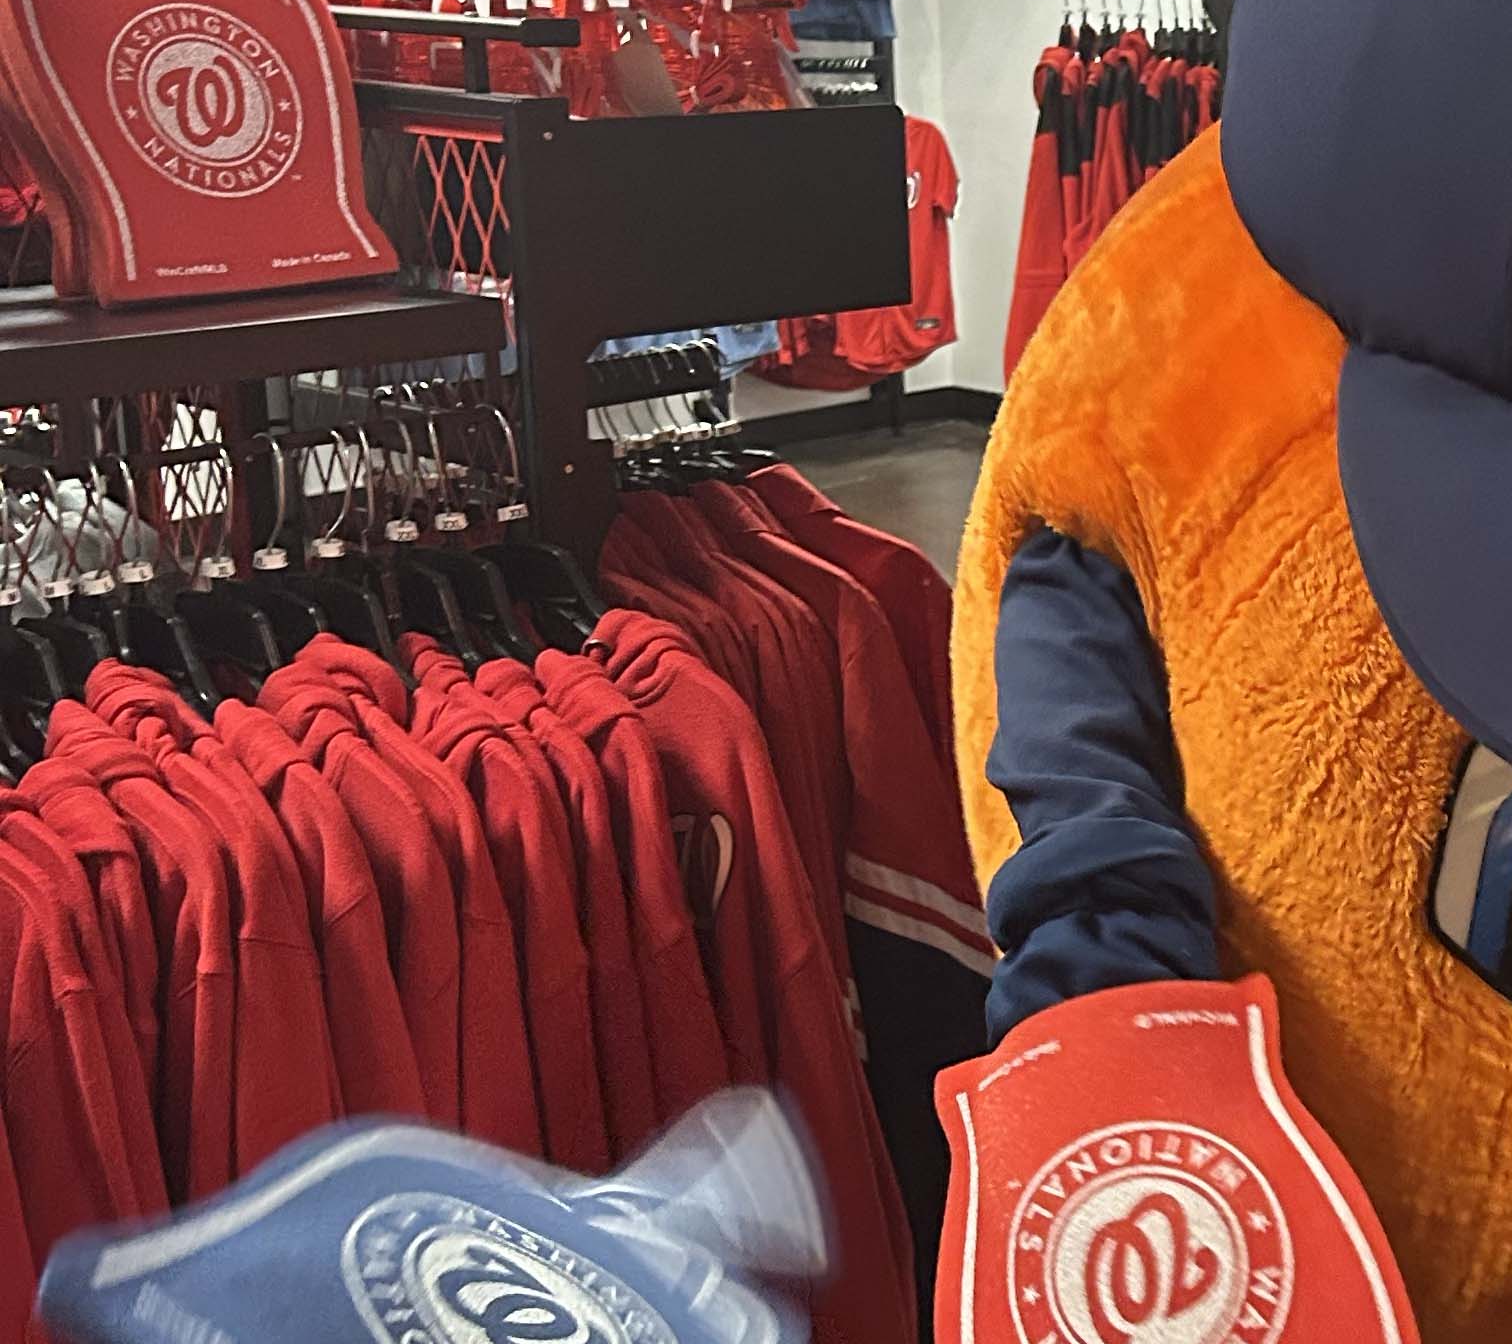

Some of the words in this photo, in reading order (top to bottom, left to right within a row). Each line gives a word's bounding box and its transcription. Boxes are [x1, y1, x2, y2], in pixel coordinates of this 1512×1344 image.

[115, 13, 281, 81] WASHINGTON
[144, 131, 292, 188] NATIONALS
[1019, 1133, 1247, 1252] NATIONALS
